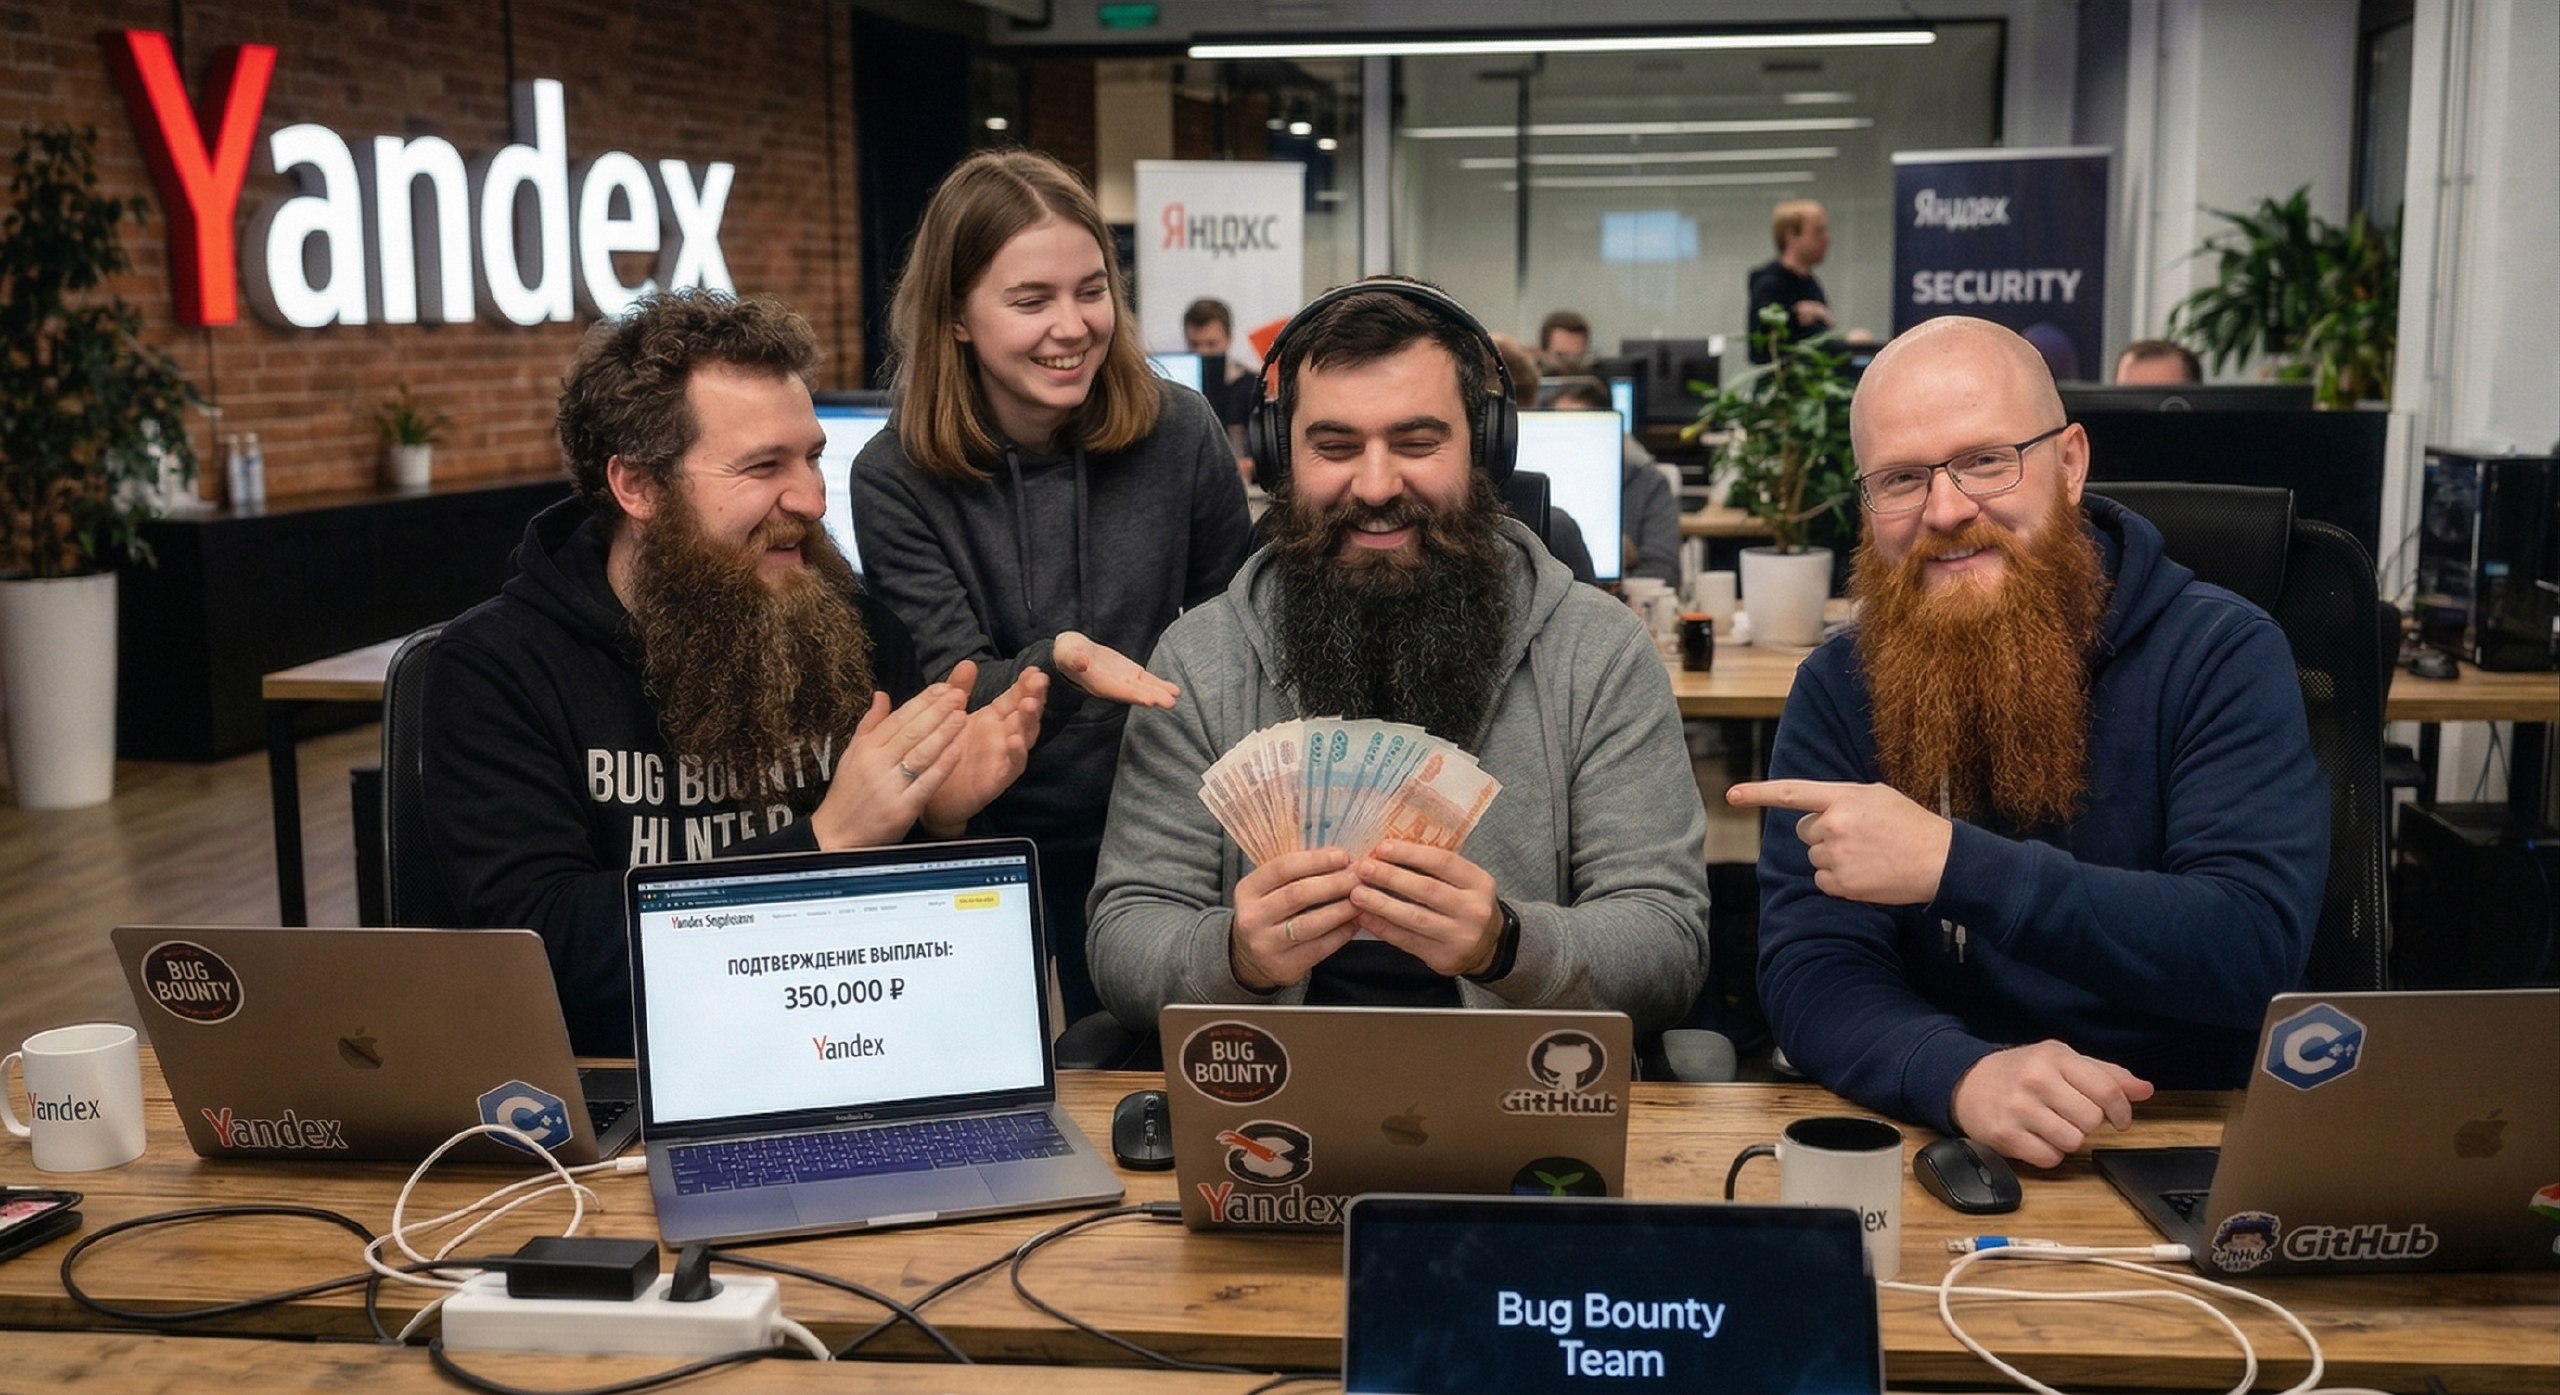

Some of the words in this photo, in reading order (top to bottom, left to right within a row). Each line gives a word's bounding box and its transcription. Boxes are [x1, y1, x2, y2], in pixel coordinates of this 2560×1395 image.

[118, 29, 736, 327] Yandex
[1912, 269, 2083, 304] SECURITY
[588, 748, 665, 806] BUG
[166, 960, 210, 980] BUG
[728, 949, 867, 977] ПОДТВЕРЖДЕНИЕ
[870, 940, 954, 963] ВЫПЛАТЫ:
[156, 981, 232, 1002] BOUNTY
[784, 978, 883, 1011] 350,000
[812, 1032, 886, 1061] Yandex
[1211, 1041, 1255, 1062] BUG
[1195, 1062, 1278, 1084] BOUNTY
[27, 1092, 101, 1121] Yandex
[202, 1107, 349, 1150] Yandex
[1198, 1181, 1350, 1224] Yandex
[2285, 1224, 2437, 1260] GitHub
[1498, 1290, 1573, 1336] Bug
[1585, 1291, 1726, 1338] Bounty
[1558, 1338, 1665, 1378] Team
